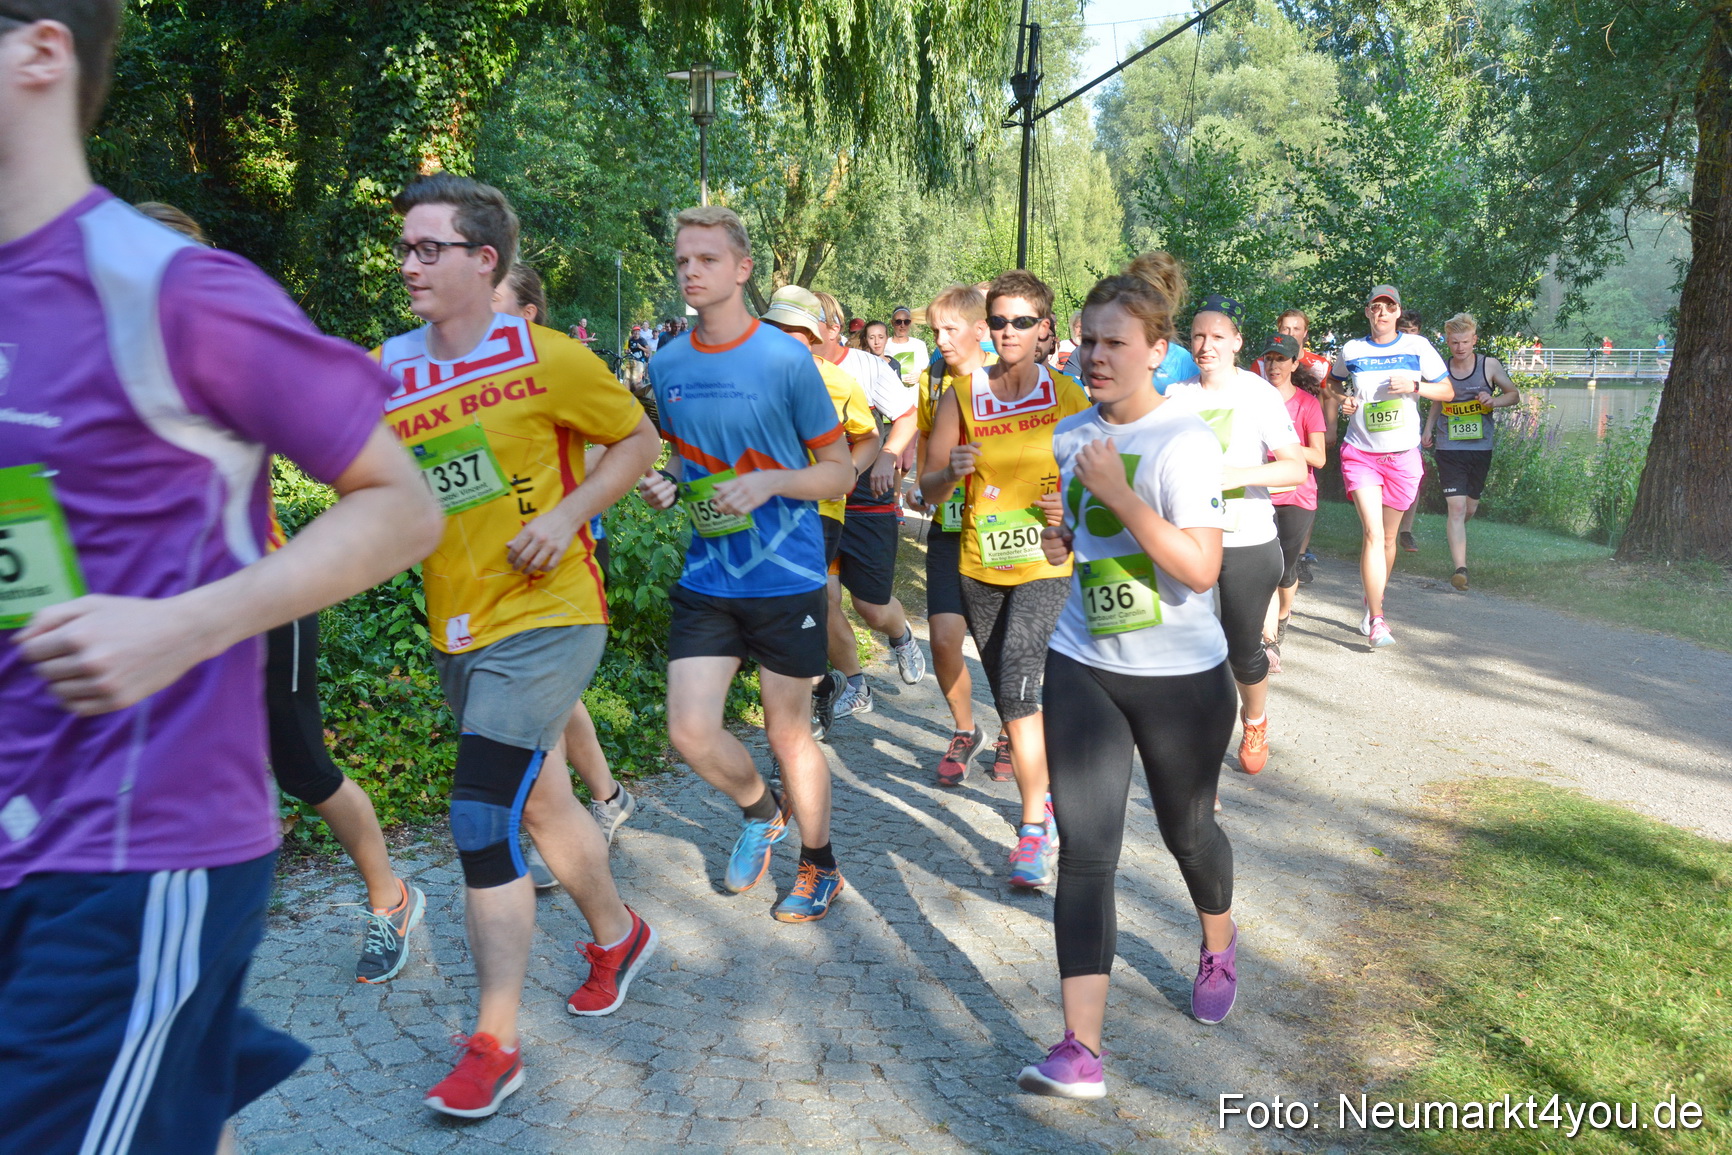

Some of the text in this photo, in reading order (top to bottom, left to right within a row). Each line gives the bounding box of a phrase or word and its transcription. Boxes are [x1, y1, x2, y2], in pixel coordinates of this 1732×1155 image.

[1370, 356, 1405, 365] PLAST
[389, 376, 548, 442] MAX BÖGL
[1369, 410, 1399, 423] 1957
[974, 412, 1058, 438] MAX BÖGL
[1452, 423, 1478, 433] 1383
[987, 527, 1039, 550] 1250
[1087, 583, 1134, 613] 136
[1119, 608, 1146, 618] Carolin
